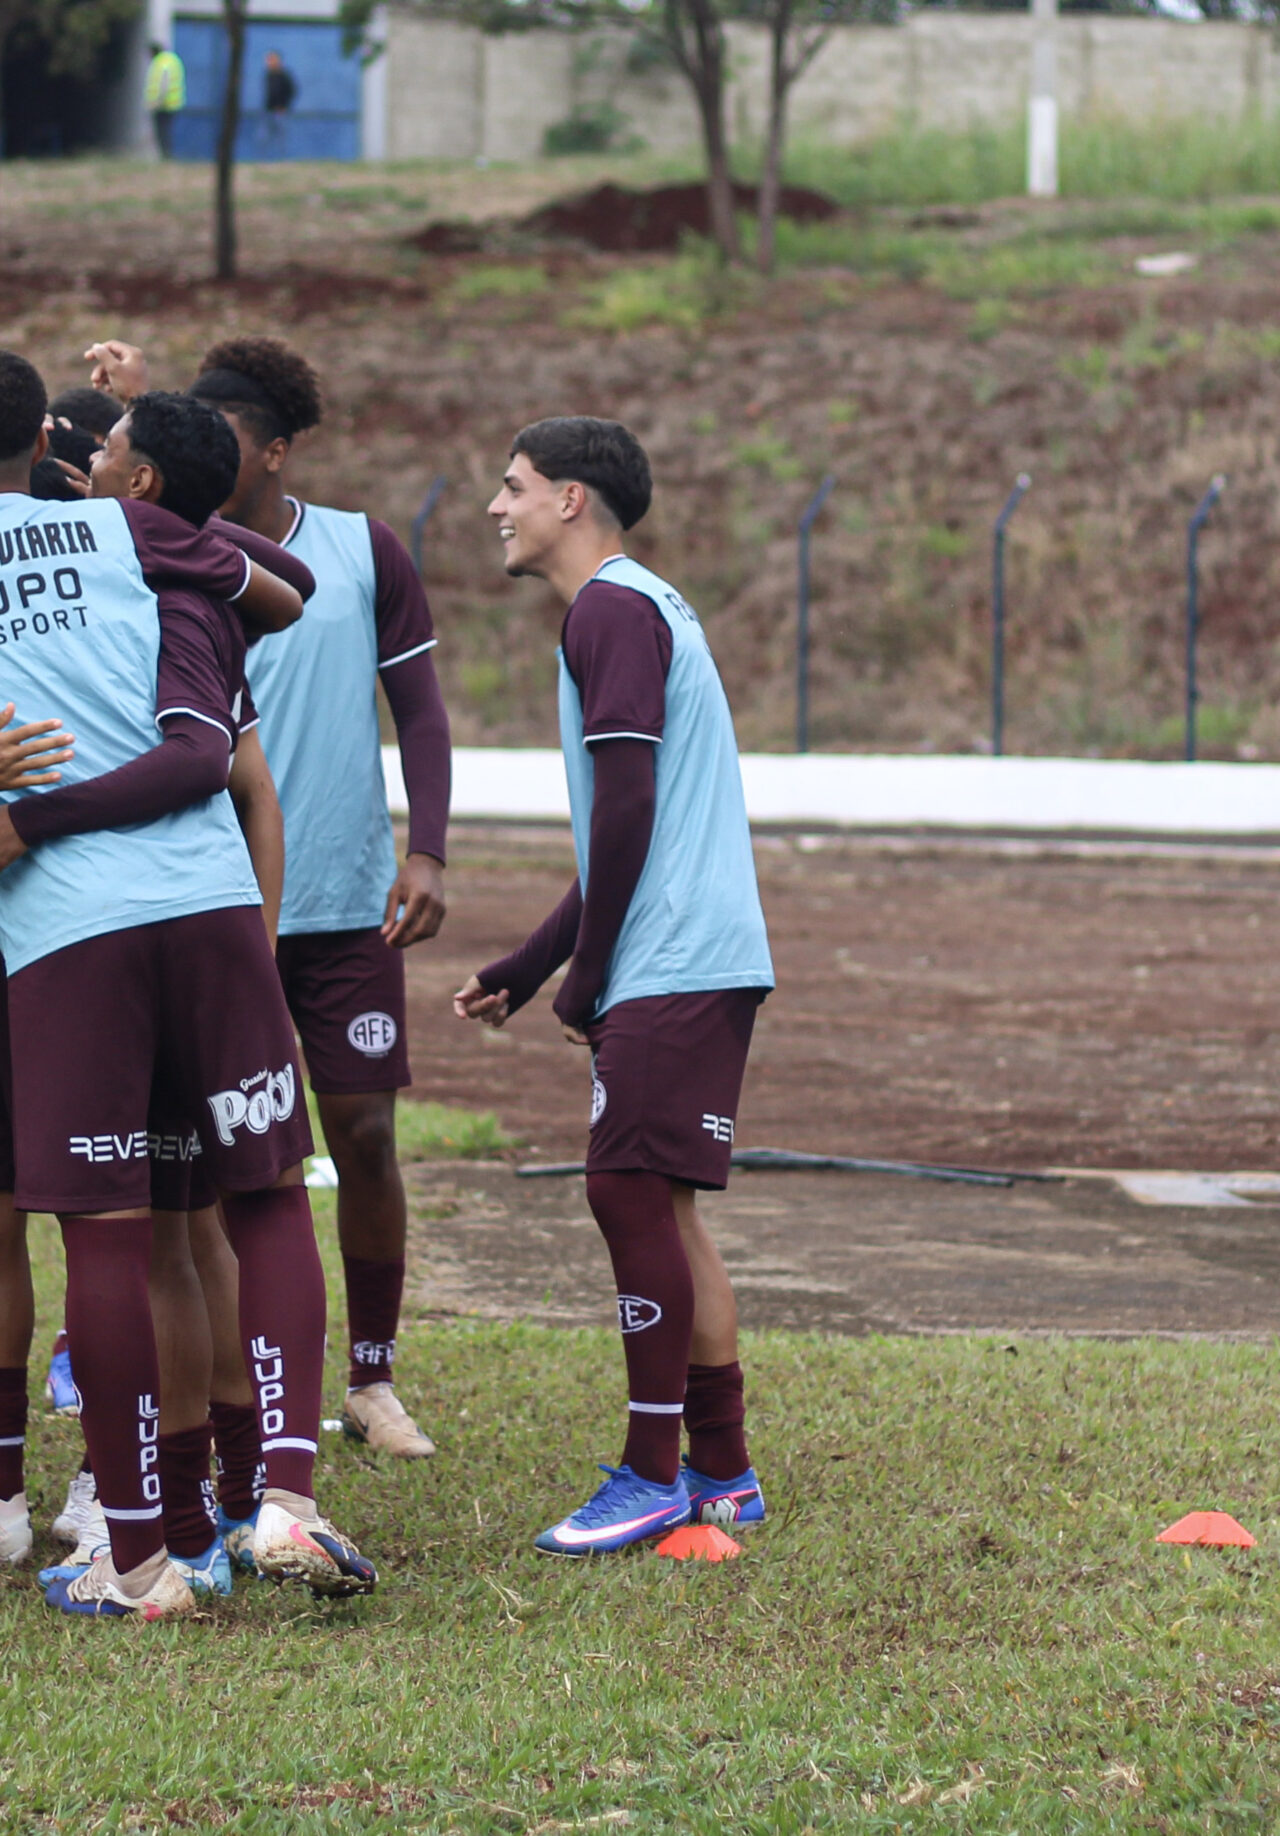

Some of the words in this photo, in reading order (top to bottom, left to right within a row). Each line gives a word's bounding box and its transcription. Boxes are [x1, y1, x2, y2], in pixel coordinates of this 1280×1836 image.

[353, 1018, 392, 1046] AFE
[251, 1335, 284, 1434] LUPO
[138, 1394, 162, 1500] LUPO
